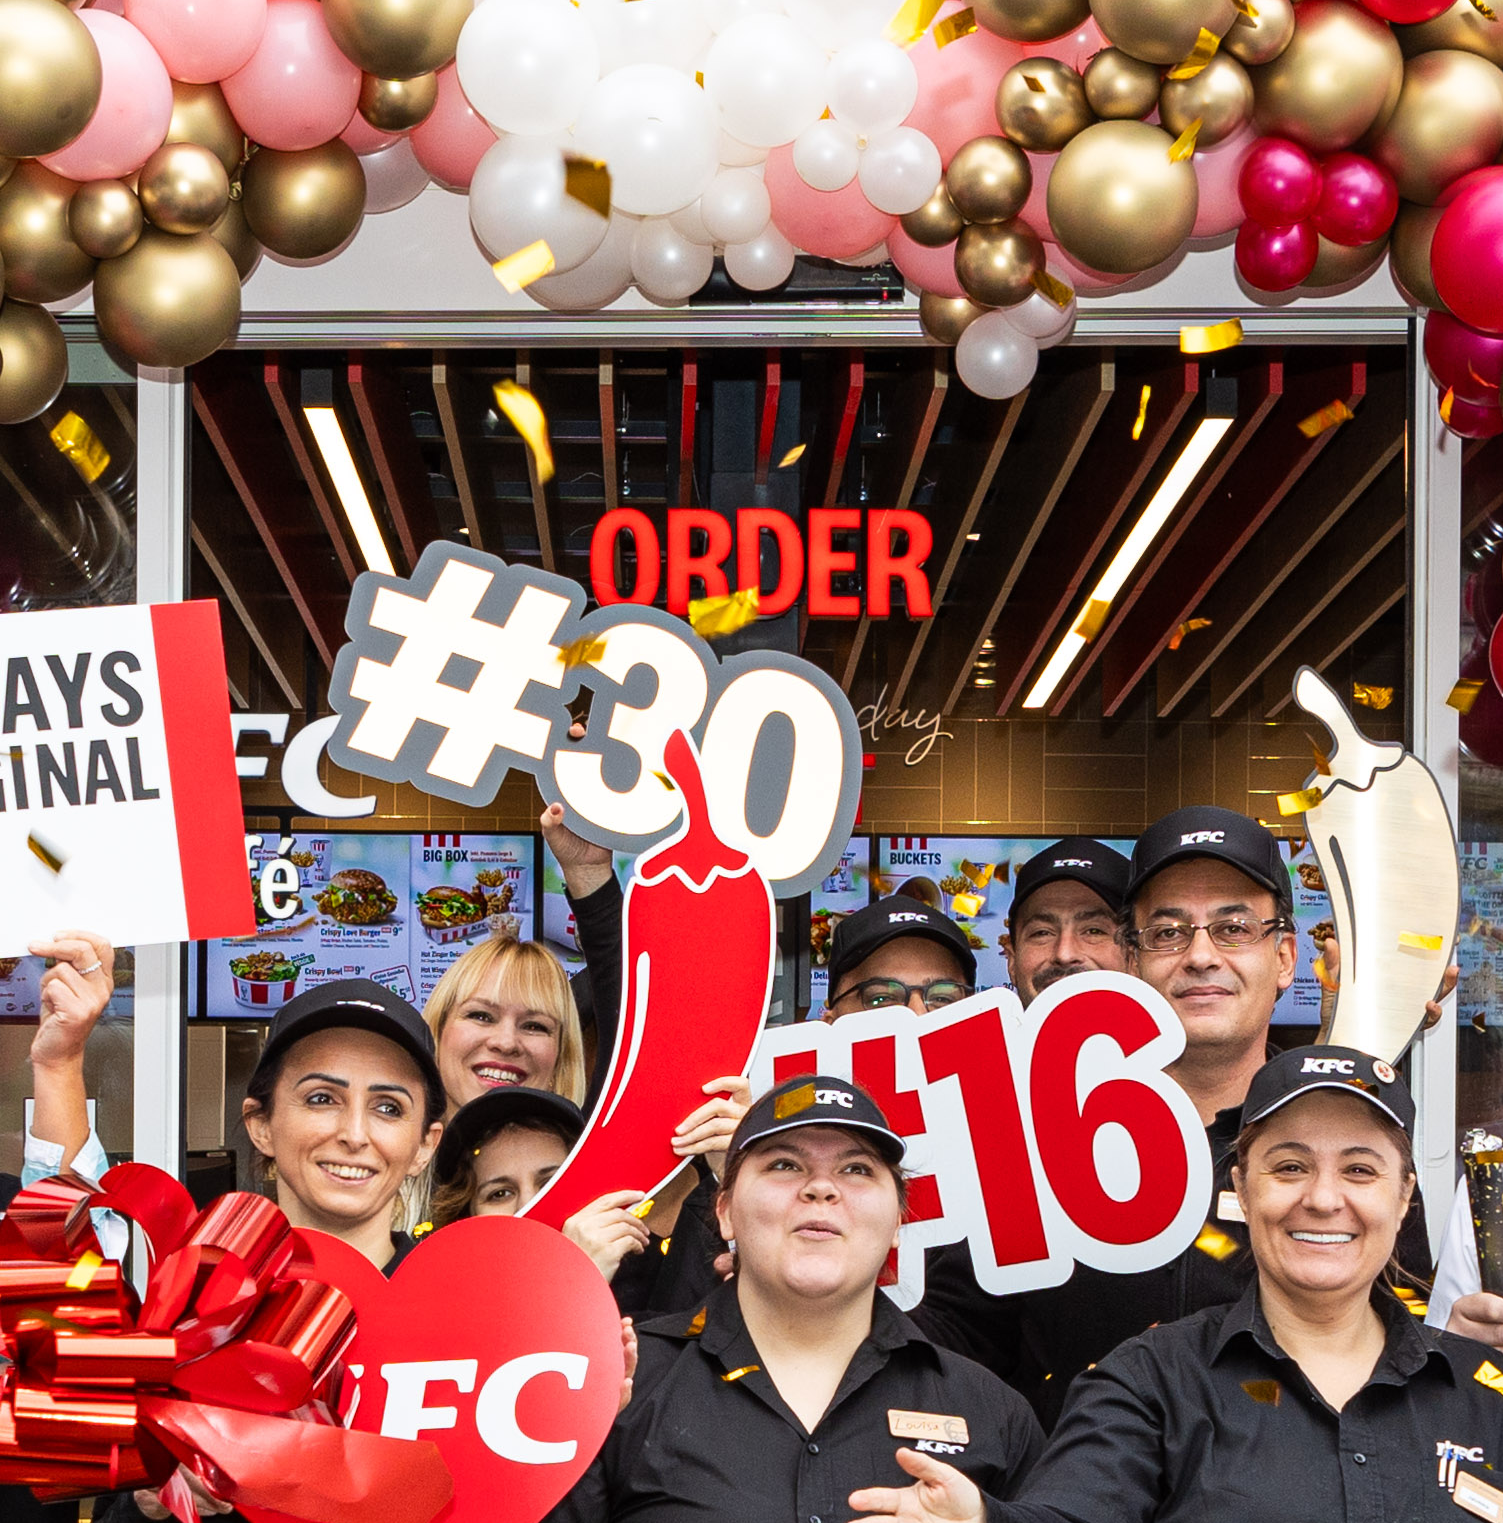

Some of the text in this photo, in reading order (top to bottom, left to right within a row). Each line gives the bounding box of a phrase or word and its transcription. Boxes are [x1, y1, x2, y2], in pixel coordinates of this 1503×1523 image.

[588, 507, 934, 618] ORDER
[348, 559, 845, 866] #30
[1179, 831, 1225, 846] KFC
[423, 850, 443, 862] BIG
[445, 850, 469, 862] BOX
[889, 852, 942, 865] BUCKETS
[1052, 858, 1093, 869] KFC
[889, 912, 929, 924] KFC
[1300, 1058, 1355, 1074] KFC
[344, 1351, 589, 1465] FC
